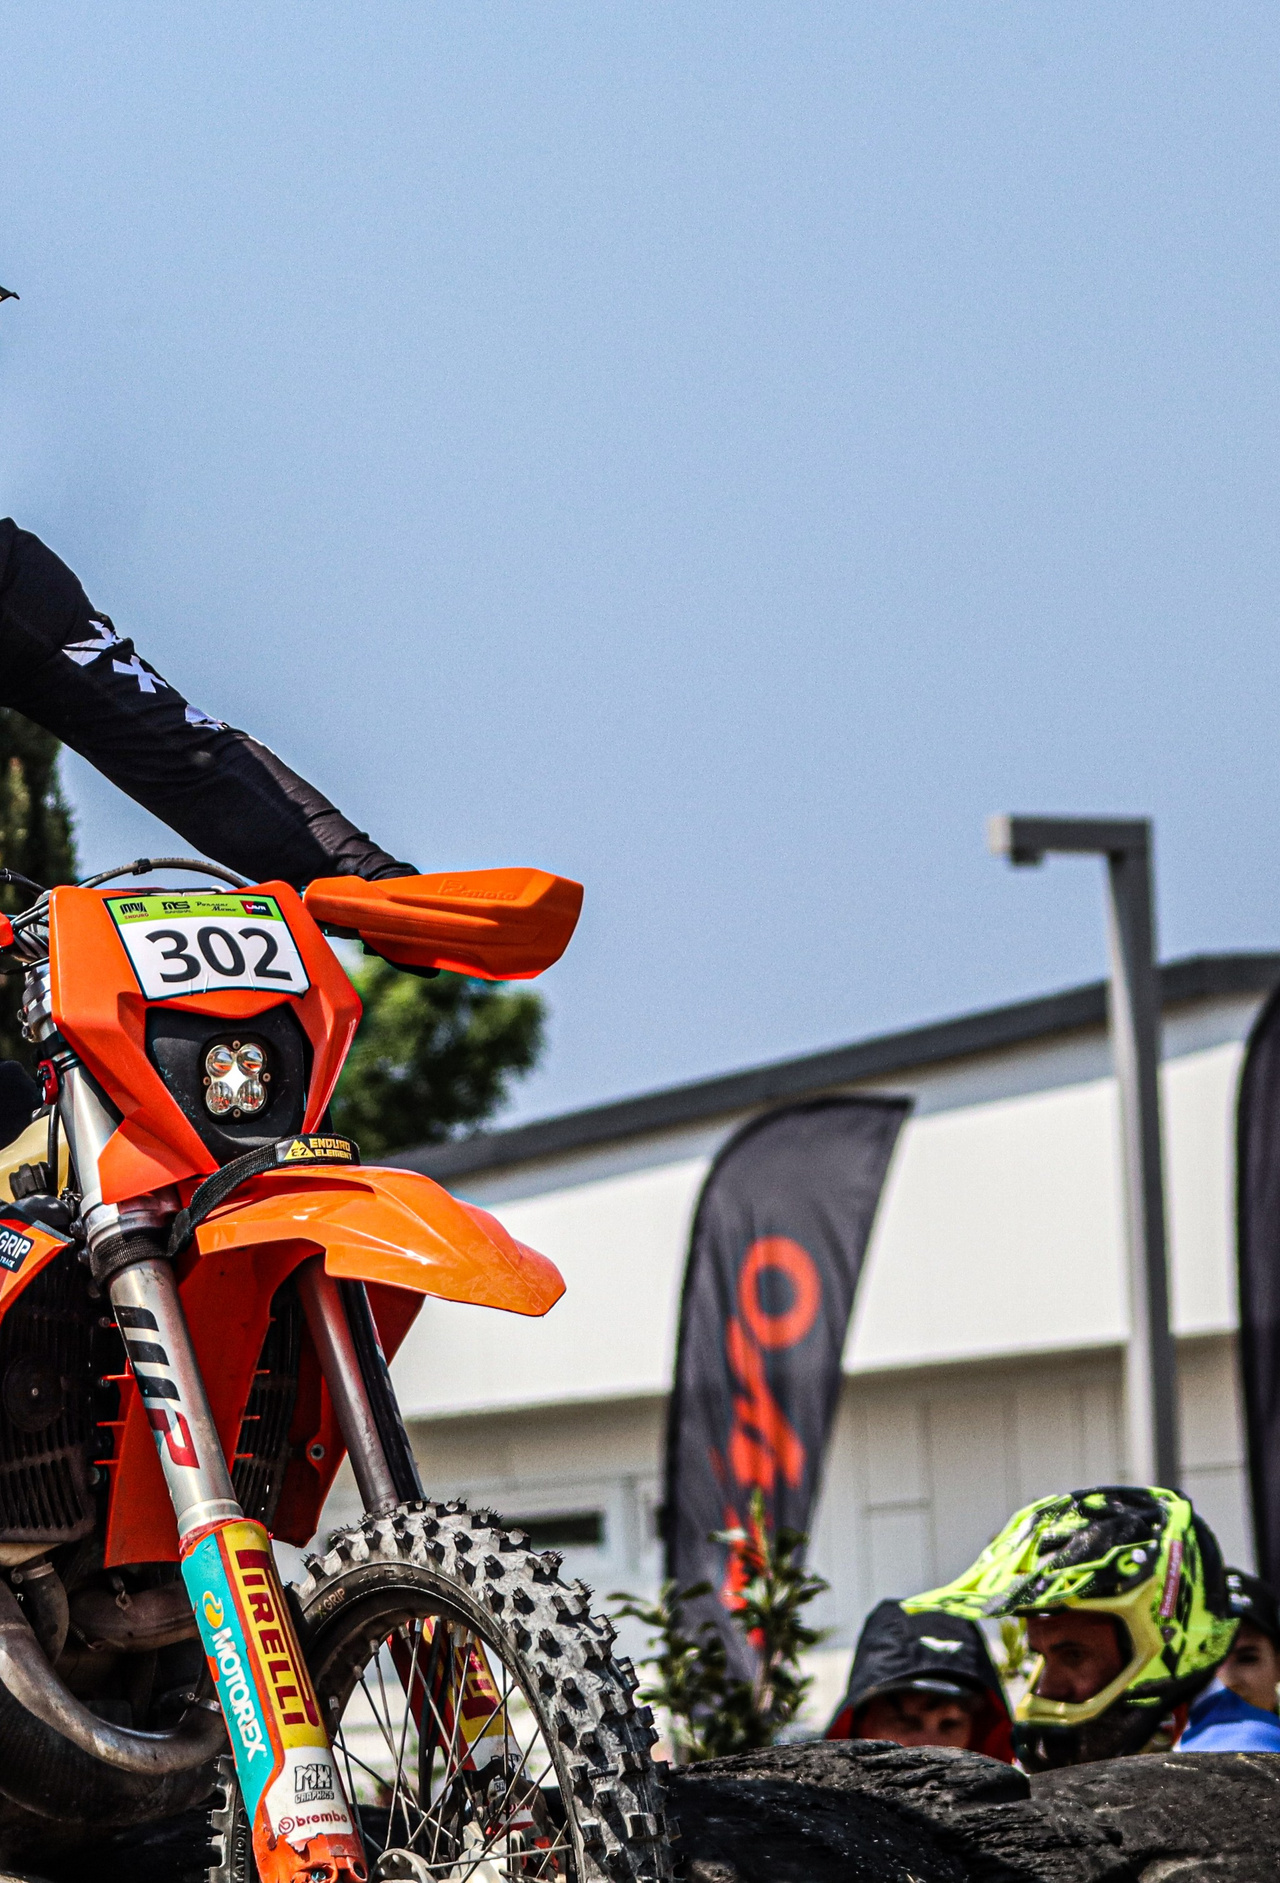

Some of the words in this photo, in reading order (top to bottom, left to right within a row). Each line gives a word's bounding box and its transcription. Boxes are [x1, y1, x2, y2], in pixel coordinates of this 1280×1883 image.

[145, 926, 293, 983] 302
[309, 1138, 351, 1152] ENDURO
[314, 1149, 352, 1160] ELEMENT
[0, 1255, 15, 1268] TRACK
[235, 1549, 319, 1727] PIRELLI
[212, 1626, 266, 1763] MOTOREX
[295, 1764, 333, 1792] MX
[296, 1811, 347, 1827] brembo
